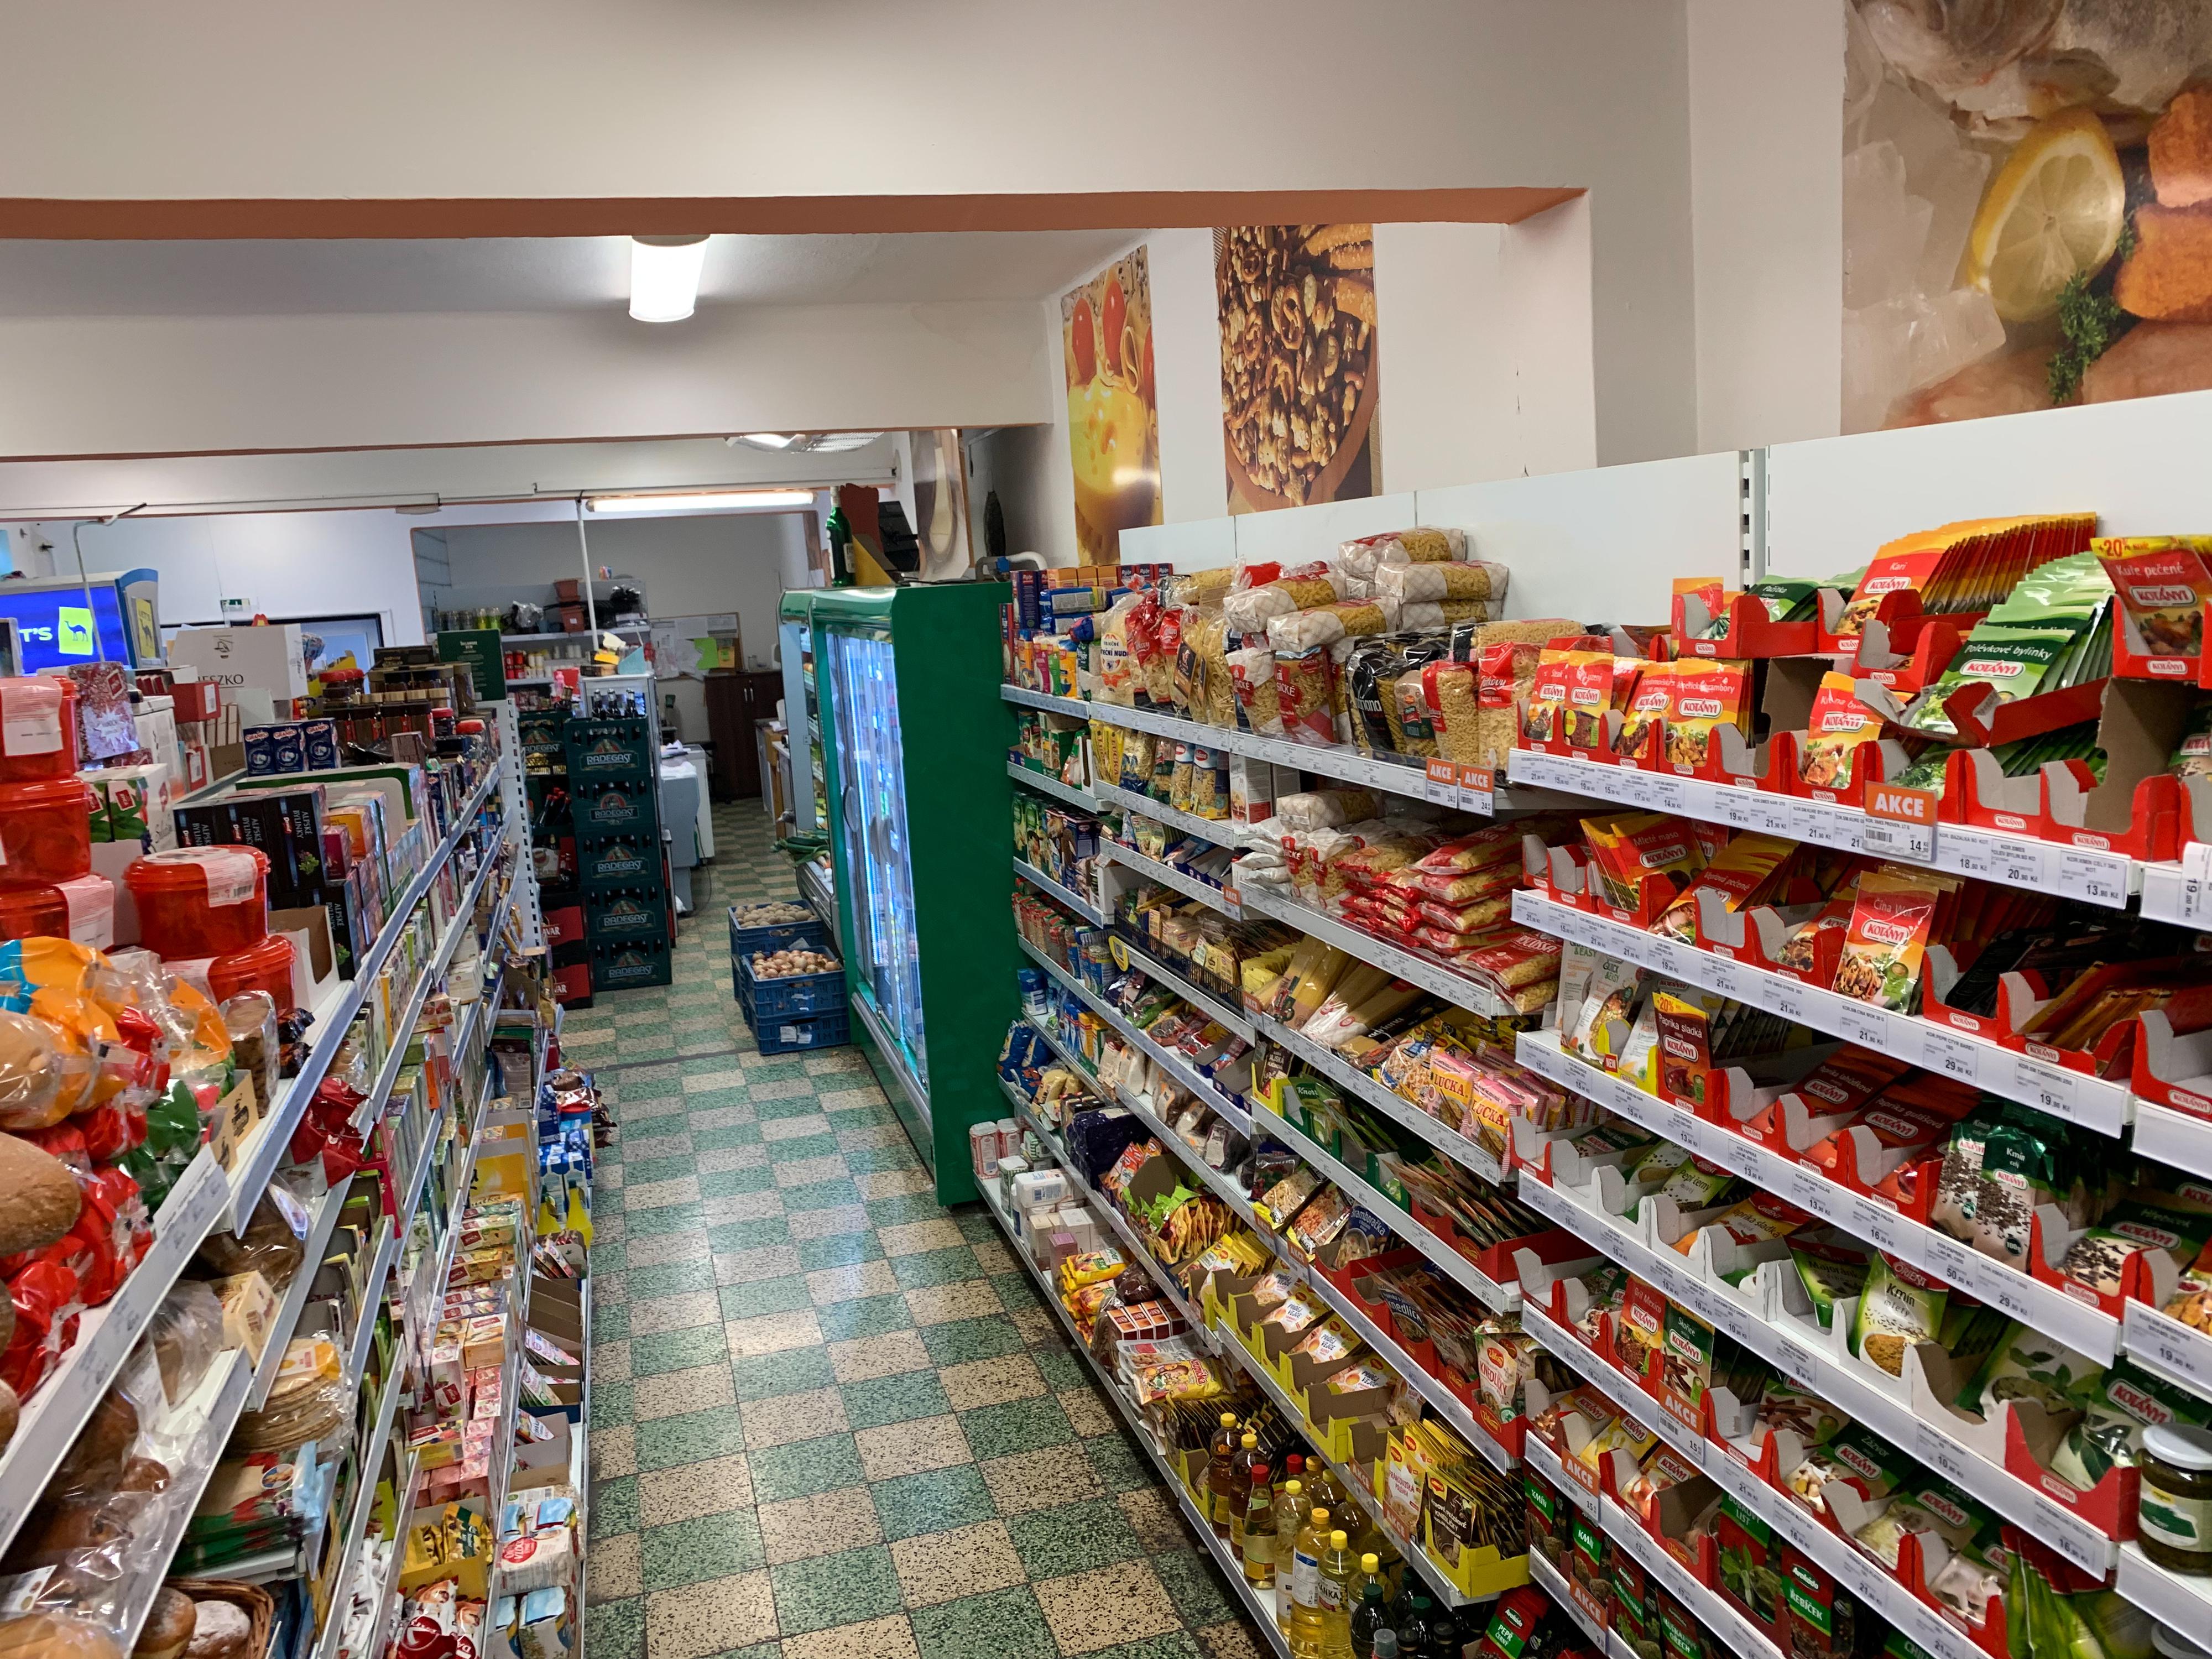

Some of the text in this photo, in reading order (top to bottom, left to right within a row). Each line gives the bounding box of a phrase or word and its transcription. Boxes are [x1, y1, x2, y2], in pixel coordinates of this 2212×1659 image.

[1890, 562, 1906, 570] Kari
[2145, 561, 2185, 578] pečené
[1869, 580, 1905, 591] KOTÁNYI
[2137, 585, 2189, 602] KOTÁNYI
[1965, 644, 2052, 660] Polévkové bylinky
[1967, 660, 2017, 675] KOTÁNYI
[2152, 661, 2183, 671] KOTÁNYI
[1873, 674, 1894, 682] KOTÁNYI
[1574, 691, 1598, 702] KOTÁNYI
[1684, 699, 1718, 713] KOTÁNYI
[307, 724, 328, 733] GRANKO
[1825, 714, 1861, 728] KOTÁNYI
[245, 733, 268, 741] GRANKO
[274, 730, 296, 739] GRANKO
[525, 744, 560, 753] ADEGAST
[587, 754, 633, 765] RADEGAST
[1430, 764, 1452, 780] AKCE
[1465, 772, 1489, 788] AKCE
[1813, 791, 1835, 800] KOTÁNYI
[594, 808, 634, 818] RADEGAST
[1875, 792, 1924, 817] AKCE
[252, 818, 263, 842] ALPSKÉ
[293, 810, 304, 839] BYLINKY
[302, 811, 312, 835] ALPSKÉ
[1998, 817, 2023, 827] KOTÁNYI
[1634, 831, 1679, 847] Mleté maso
[1910, 840, 1921, 851] 14
[2077, 836, 2105, 847] KOTÁNYI
[1646, 847, 1684, 865] KOTÁNYI
[598, 860, 643, 873] RADEGAST
[1225, 890, 1237, 901] AKCE
[1874, 898, 1891, 912] Čína
[604, 914, 648, 927] RADEGAST
[1867, 924, 1905, 940] KOTÁNYI
[609, 964, 653, 978] RADEGAST
[1244, 996, 1259, 1010] AKCE
[1658, 1014, 1702, 1039] Paprika sladká
[1953, 1015, 1977, 1029] KOTÁNYI
[1667, 1040, 1694, 1058] KOTÁNYI
[2030, 1045, 2057, 1060] KOTÁNYI
[1296, 1087, 1318, 1097] Knorr
[1434, 1073, 1464, 1097] LUCKA
[1810, 1083, 1842, 1100] KOTÁNYI
[2173, 1093, 2208, 1110] KOTÁNYI
[1473, 1100, 1505, 1126] LUCKA
[1903, 1110, 1944, 1129] gulášová
[1872, 1114, 1912, 1135] KOTÁNYI
[2006, 1147, 2025, 1161] Kmín
[1678, 1169, 1712, 1192] Pepř černý
[1997, 1172, 2023, 1187] KOTÁNYI
[1755, 1220, 1780, 1238] sladká
[2119, 1223, 2173, 1245] KOTÁNYI
[1893, 1261, 1927, 1287] ORIENT
[1887, 1284, 1915, 1307] Kmín
[2067, 1286, 2096, 1303] KOTÁNYI
[1643, 1295, 1661, 1313] Mexico
[1287, 1309, 1302, 1317] VEJCE
[1634, 1308, 1655, 1331] KOTÁNYI
[1678, 1317, 1695, 1337] Skořice
[1321, 1342, 1336, 1351] VEJCE
[1672, 1336, 1700, 1361] KOTÁNYI
[1361, 1378, 1378, 1387] VEJCE
[1578, 1398, 1603, 1418] KOTÁNYI
[1666, 1394, 1697, 1429] AKCE
[2113, 1384, 2167, 1426] KOTÁNYI
[1624, 1420, 1645, 1440] KOTÁNYI
[1690, 1440, 1698, 1452] 15
[1861, 1436, 1890, 1456] Zázvor
[1660, 1459, 1688, 1480] KOTÁNYI
[1841, 1447, 1877, 1477] KOTÁNYI
[1567, 1459, 1594, 1490] AKCE
[1531, 1489, 1547, 1508] KMÍN
[1923, 1494, 1963, 1522] KOTÁNYI
[1736, 1510, 1749, 1525] LIST
[1578, 1530, 1594, 1549] KMÍN
[1793, 1567, 1818, 1589] Avokádo
[1317, 1583, 1339, 1600] ANKA
[1575, 1588, 1601, 1621] AKCE
[1790, 1588, 1822, 1621] ŘEBÍČEK
[1495, 1632, 1509, 1646] ČERNÝ
[1498, 1624, 1513, 1641] PEPŘ
